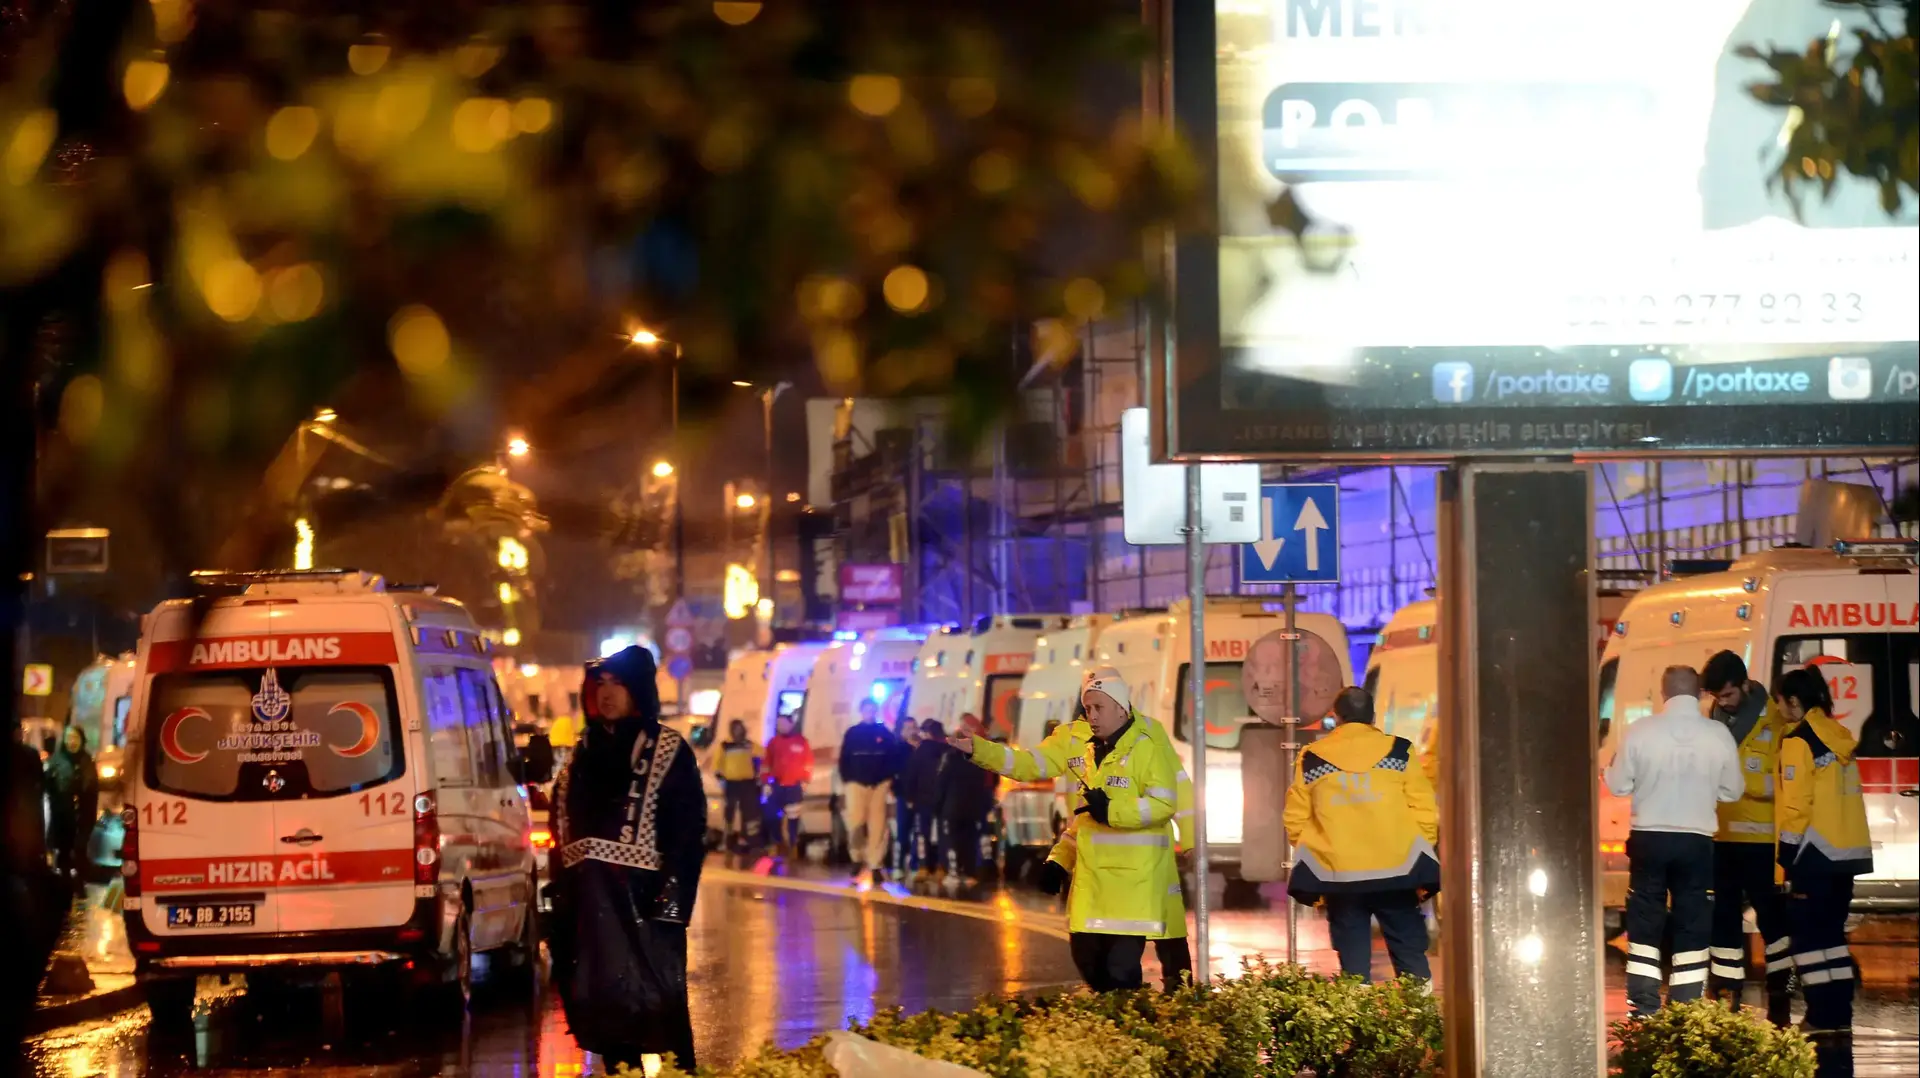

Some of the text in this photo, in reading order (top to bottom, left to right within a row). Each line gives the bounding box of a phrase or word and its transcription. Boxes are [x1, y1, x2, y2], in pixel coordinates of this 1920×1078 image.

[1821, 292, 1864, 324] 33
[1482, 368, 1611, 399] /portaxe
[1682, 366, 1811, 398] /portaxe
[190, 637, 342, 664] AMBULANS
[142, 802, 188, 825] 112
[359, 792, 407, 816] 112
[279, 850, 335, 881] ACİL
[176, 907, 193, 924] 34
[219, 905, 252, 922] 3155
